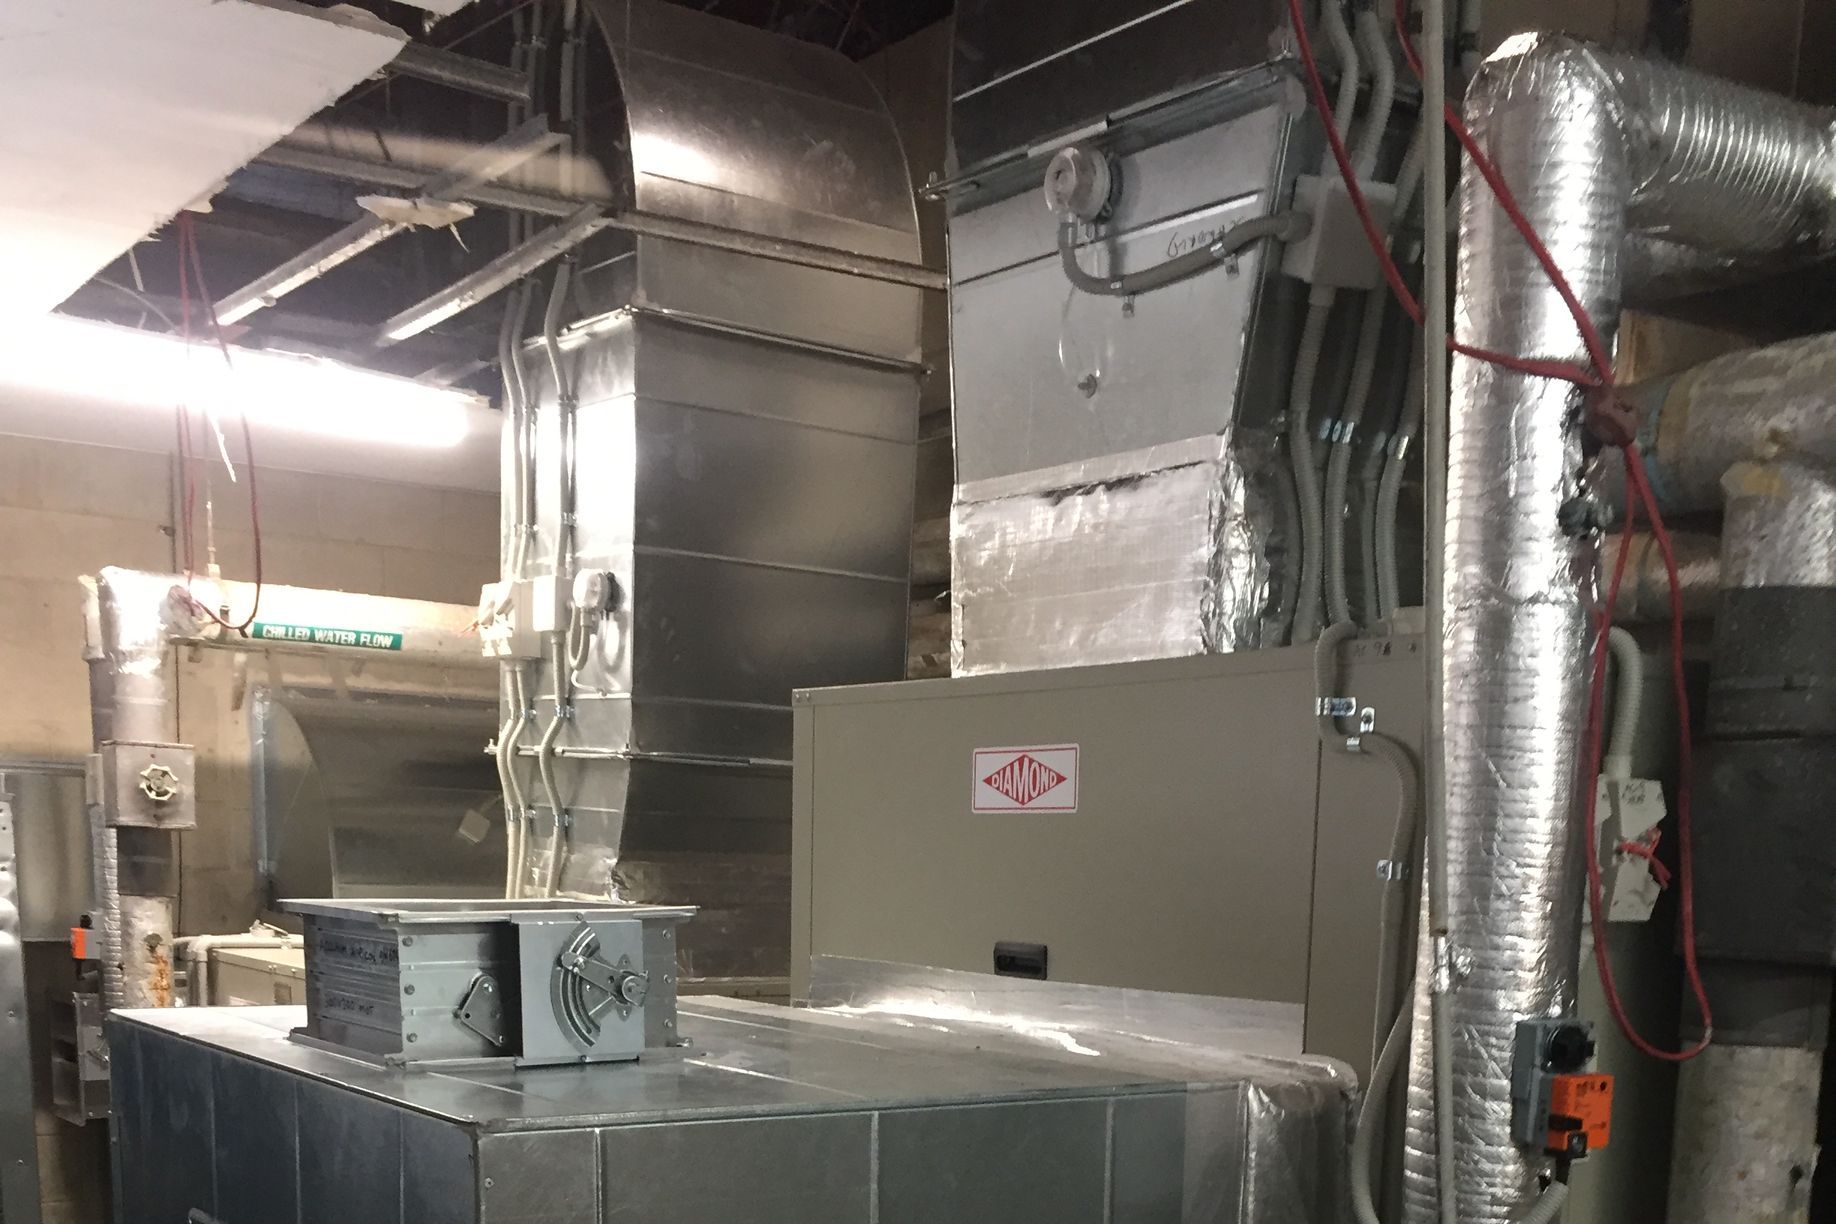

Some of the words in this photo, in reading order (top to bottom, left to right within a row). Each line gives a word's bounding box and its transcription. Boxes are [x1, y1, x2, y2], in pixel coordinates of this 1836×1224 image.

[262, 625, 311, 641] CHILLED
[314, 629, 356, 645] WATER
[359, 633, 394, 648] FLOW
[991, 757, 1057, 803] DIAMOND
